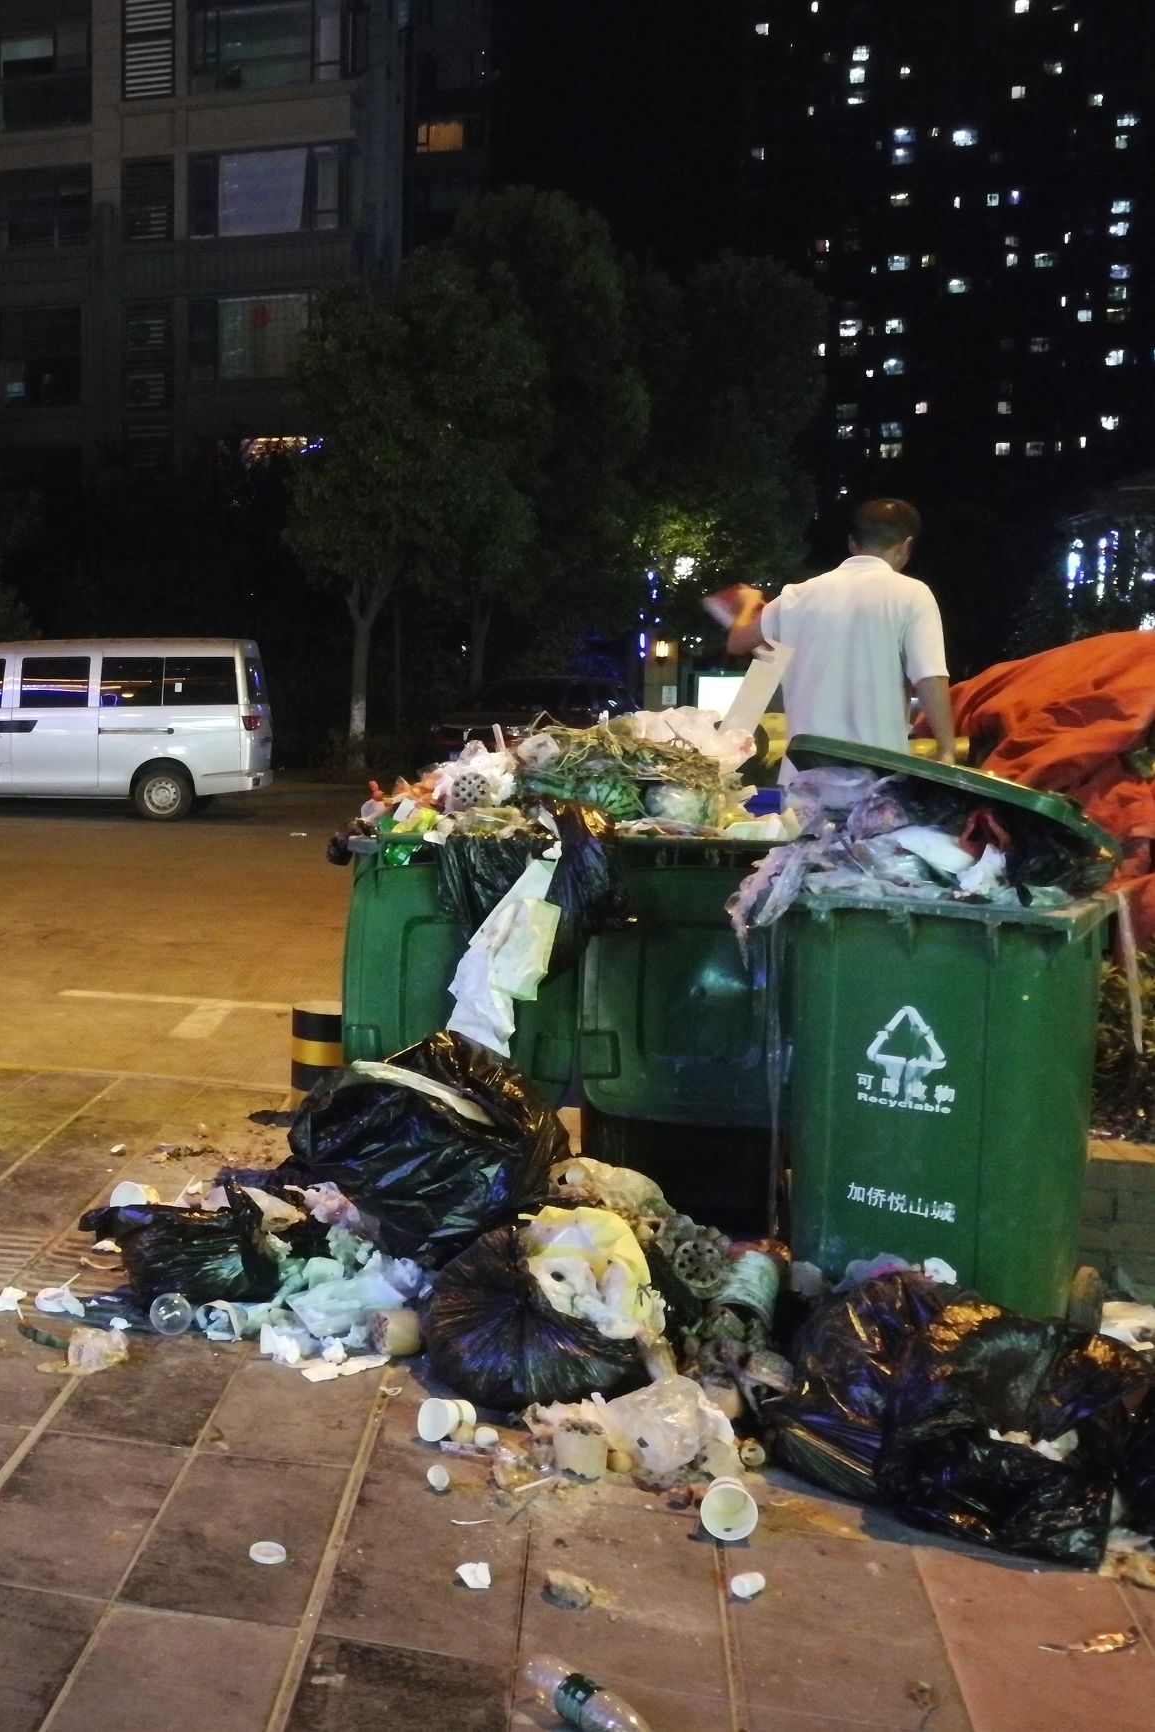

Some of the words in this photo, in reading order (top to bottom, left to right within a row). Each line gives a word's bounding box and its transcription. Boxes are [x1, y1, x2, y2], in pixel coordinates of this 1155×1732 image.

[857, 1092, 951, 1114] Recyclable
[847, 1182, 956, 1223] 加侨悦山城
